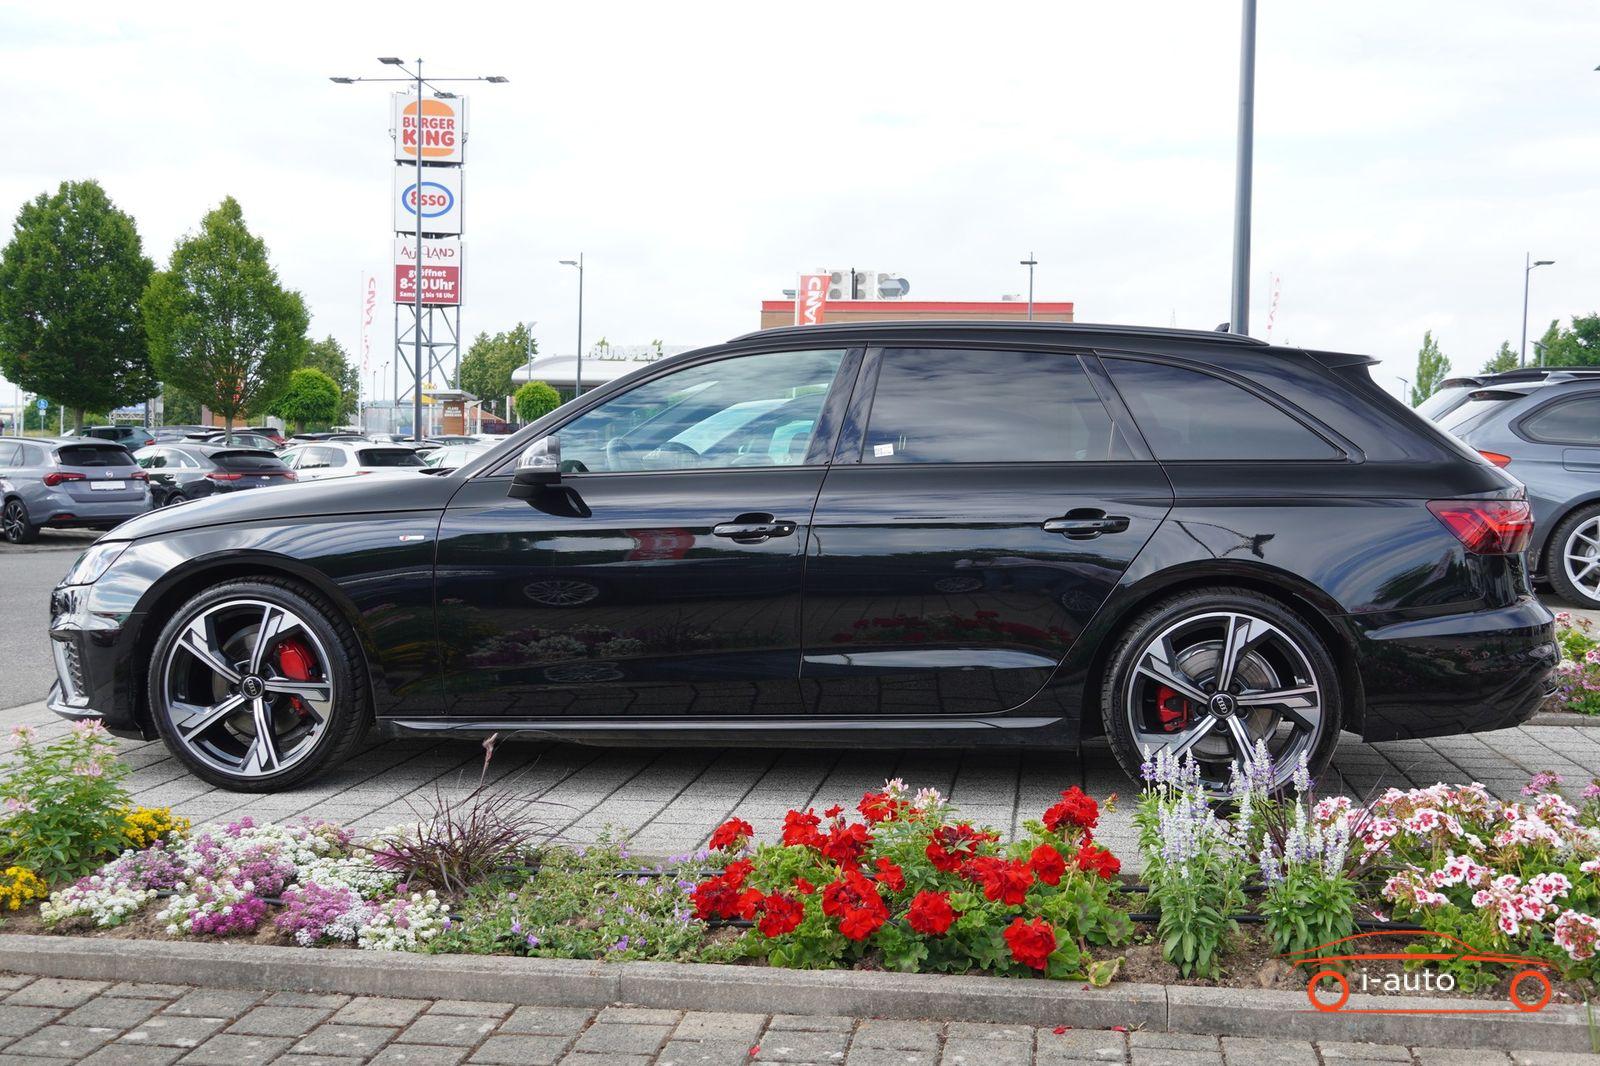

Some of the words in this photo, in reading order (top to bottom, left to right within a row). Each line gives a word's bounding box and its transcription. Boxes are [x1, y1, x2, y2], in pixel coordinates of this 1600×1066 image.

[403, 116, 454, 129] BURGER
[403, 129, 454, 147] KING
[430, 279, 455, 290] Uhr
[400, 291, 424, 299] Samsg
